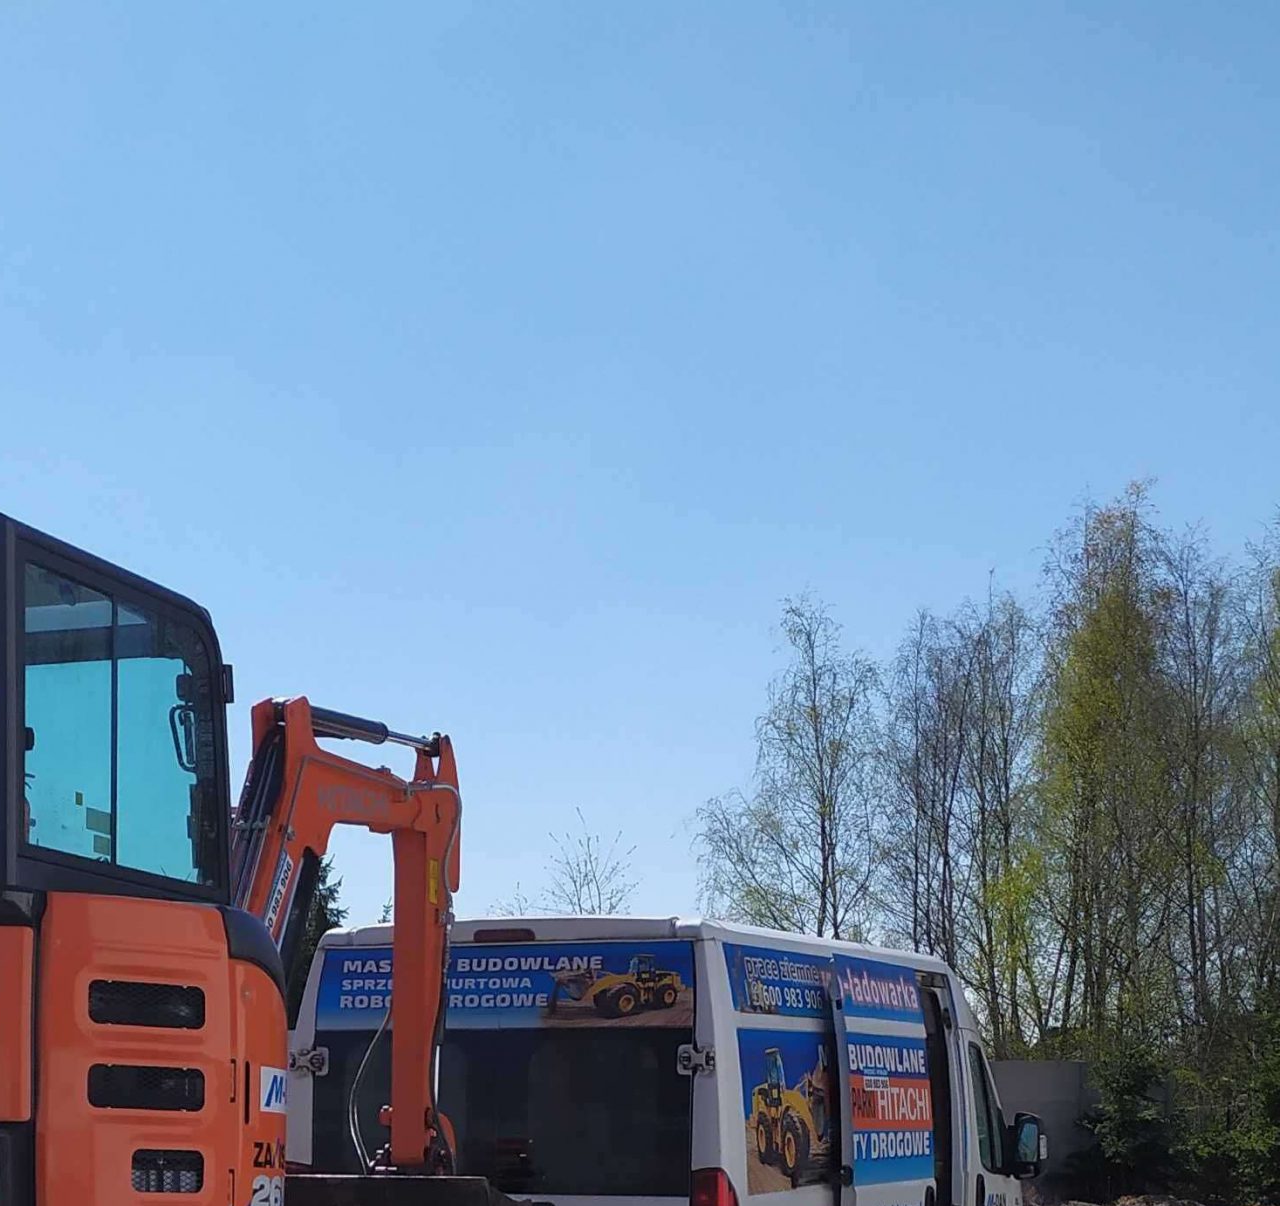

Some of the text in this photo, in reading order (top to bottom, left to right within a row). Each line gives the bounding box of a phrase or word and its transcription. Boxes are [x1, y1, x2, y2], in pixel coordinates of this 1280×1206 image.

[343, 956, 603, 973] MAS BUDOWLANE
[744, 956, 820, 984] prace ziemne
[449, 992, 549, 1008] ROGOWE
[763, 985, 783, 1007] 600
[784, 987, 804, 1009] 983
[848, 1043, 926, 1074] BUDOWLANE
[877, 1087, 930, 1121] HITACHI
[871, 1131, 930, 1160] DROGOWE
